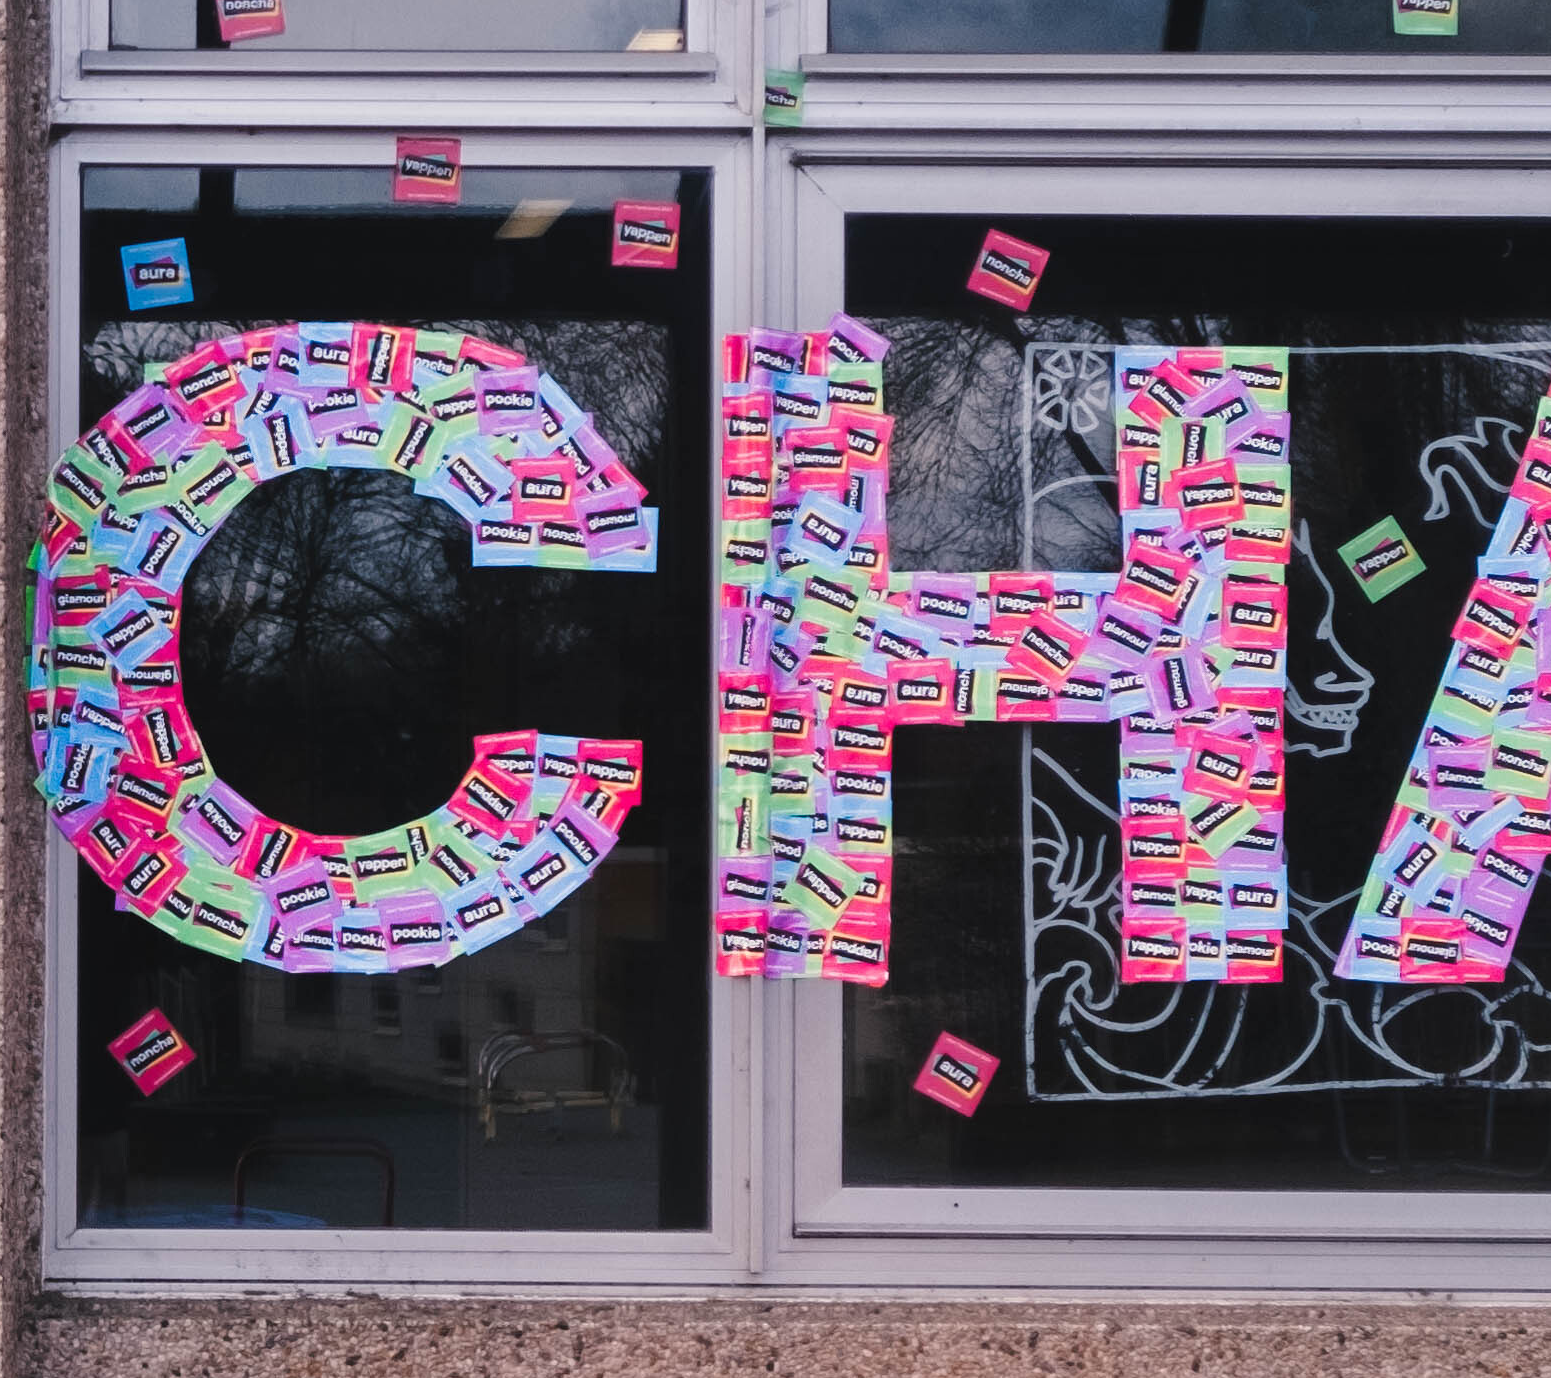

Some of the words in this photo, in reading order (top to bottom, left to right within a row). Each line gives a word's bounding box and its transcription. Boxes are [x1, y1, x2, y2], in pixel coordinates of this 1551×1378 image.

[405, 158, 452, 182] yappen
[624, 225, 671, 244] yappen
[139, 268, 179, 283] aura
[986, 256, 1030, 285] noncha
[371, 333, 391, 380] yappen
[183, 370, 229, 395] noncha
[61, 468, 101, 506] noncha
[525, 483, 562, 496] aura
[1184, 488, 1233, 502] yappen
[588, 513, 635, 530] glamour
[144, 532, 177, 574] pookie
[1359, 545, 1406, 573] yappen
[1130, 566, 1177, 598] glamour
[810, 582, 856, 609] noncha
[1235, 608, 1273, 623] aura
[1471, 603, 1515, 636] yappen
[106, 616, 154, 647] yappen
[1027, 632, 1069, 667] noncha
[901, 685, 938, 698] aura
[838, 730, 885, 747] yappen
[1202, 756, 1238, 777] aura
[1497, 752, 1547, 774] noncha
[122, 780, 168, 806] glamour
[204, 802, 242, 842] pookie
[1132, 838, 1180, 855] yappen
[131, 859, 161, 889] aura
[1402, 848, 1433, 879] aura
[279, 886, 327, 910] pookie
[803, 868, 842, 905] yappen
[1236, 890, 1274, 904] aura
[198, 908, 243, 936] noncha
[392, 926, 440, 942] pookie
[831, 941, 878, 960] yappen
[1131, 940, 1179, 956] yappen
[130, 1036, 174, 1067] noncha
[939, 1061, 973, 1088] aura
